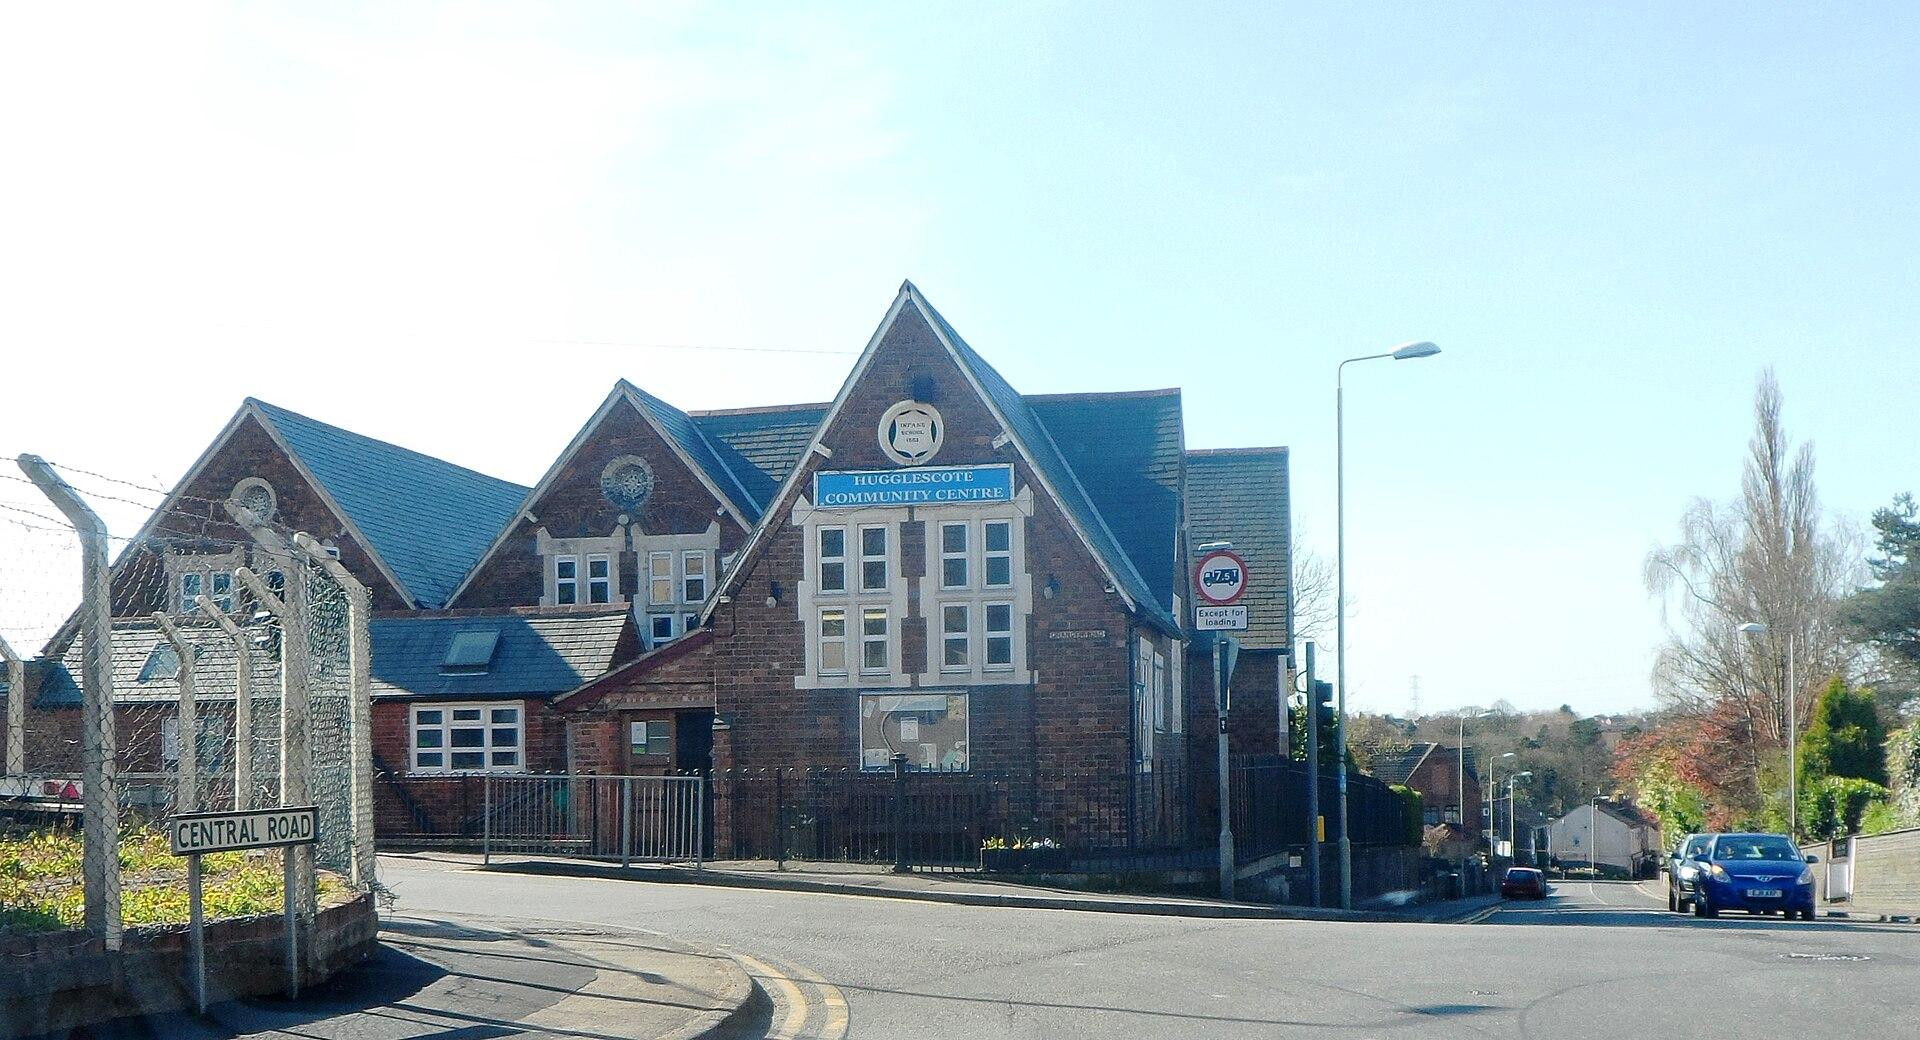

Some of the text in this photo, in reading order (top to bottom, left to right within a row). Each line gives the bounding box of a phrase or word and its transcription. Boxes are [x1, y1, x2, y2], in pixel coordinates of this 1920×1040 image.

[854, 472, 974, 486] HUGGLESCOTE
[825, 487, 1004, 504] COMMUNITY CENTRE
[1199, 609, 1228, 617] Except
[1206, 619, 1237, 627] loading
[178, 815, 311, 848] CENTRAL ROAD
